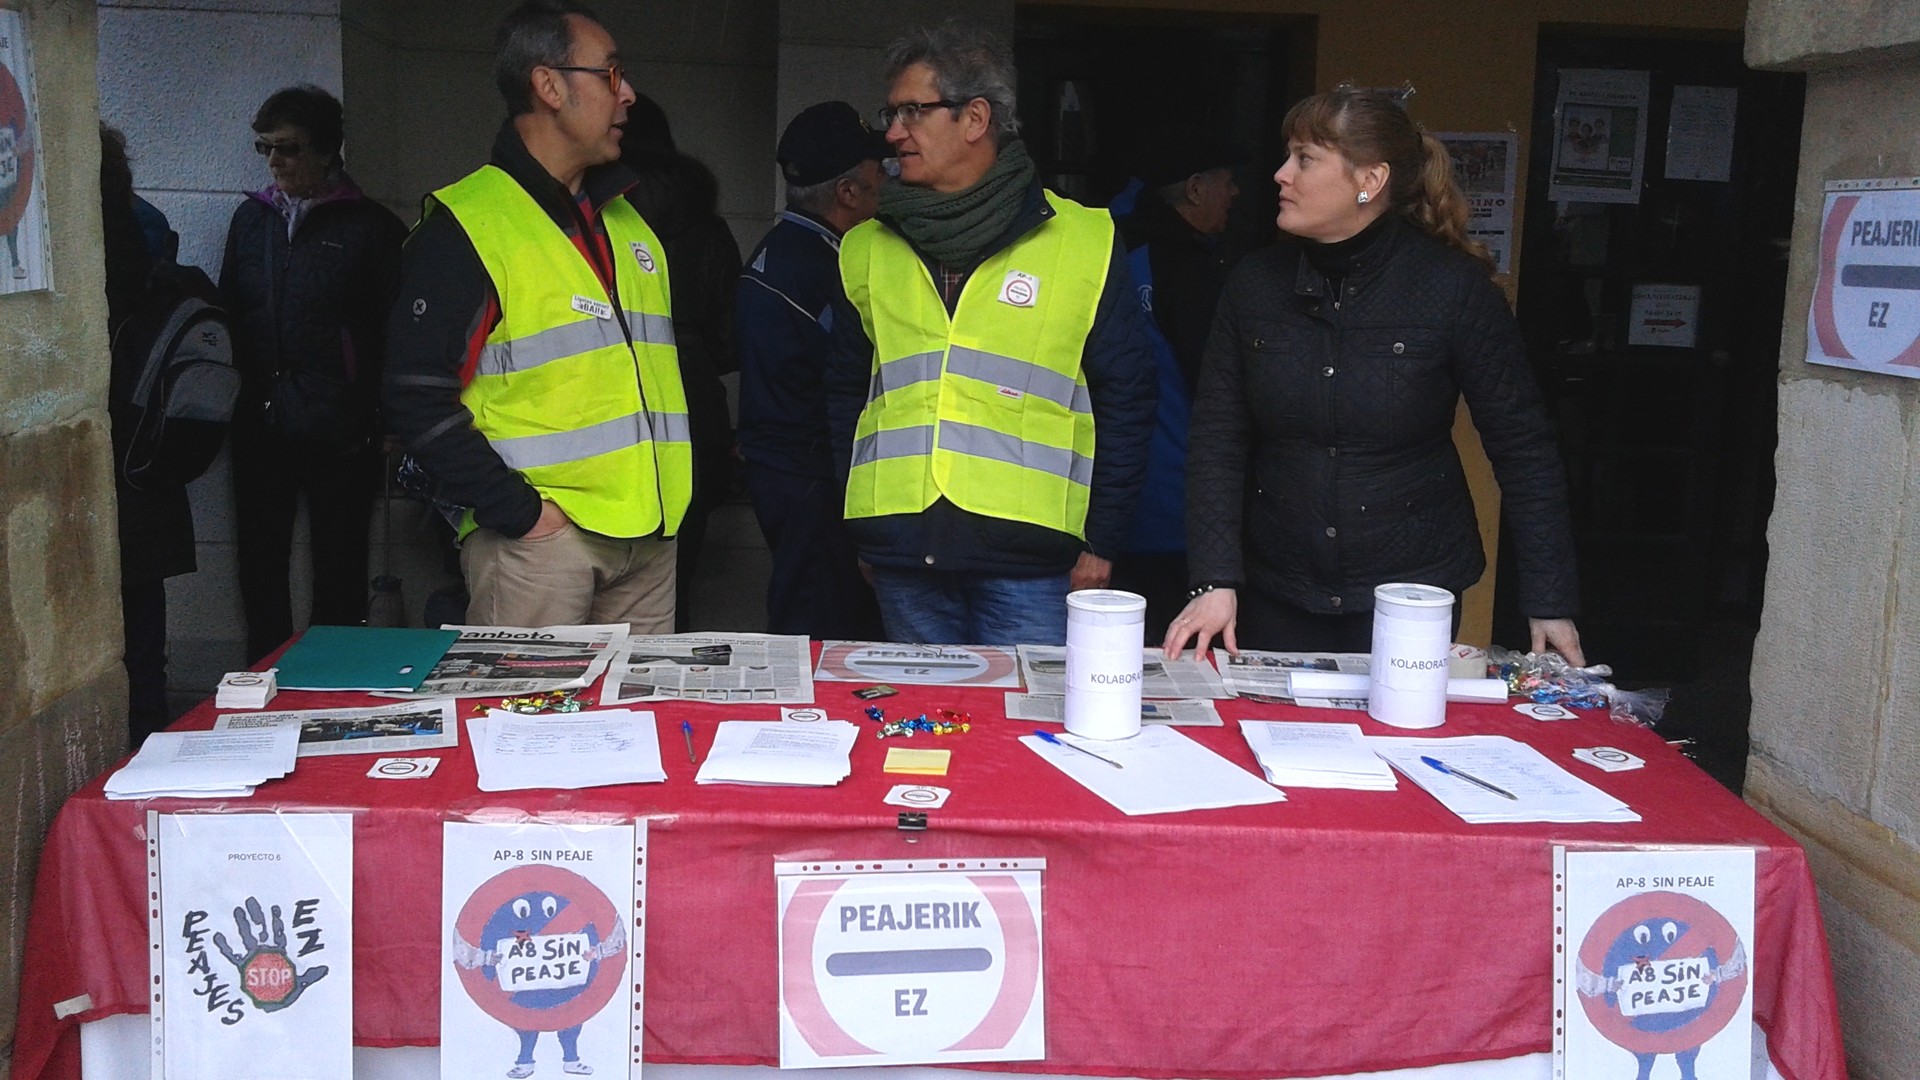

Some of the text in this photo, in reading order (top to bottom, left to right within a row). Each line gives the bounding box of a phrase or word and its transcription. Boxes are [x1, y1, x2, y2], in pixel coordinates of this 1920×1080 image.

[1851, 220, 1920, 247] PEAJERI
[1868, 301, 1890, 328] EZ
[463, 631, 555, 640] anboto
[228, 853, 282, 862] PROYECTO 6
[493, 849, 594, 861] AP-8 SIN PEAJE
[1616, 876, 1715, 888] AP-8 SIN PEAJE
[840, 901, 982, 933] PEAJERIK
[508, 944, 536, 961] A8
[183, 910, 246, 1026] PEAJES
[247, 968, 292, 988] STOP
[511, 959, 582, 984] PEAJE
[1628, 967, 1656, 984] A8
[894, 988, 928, 1017] EZ
[1631, 984, 1701, 1009] PEAJE
